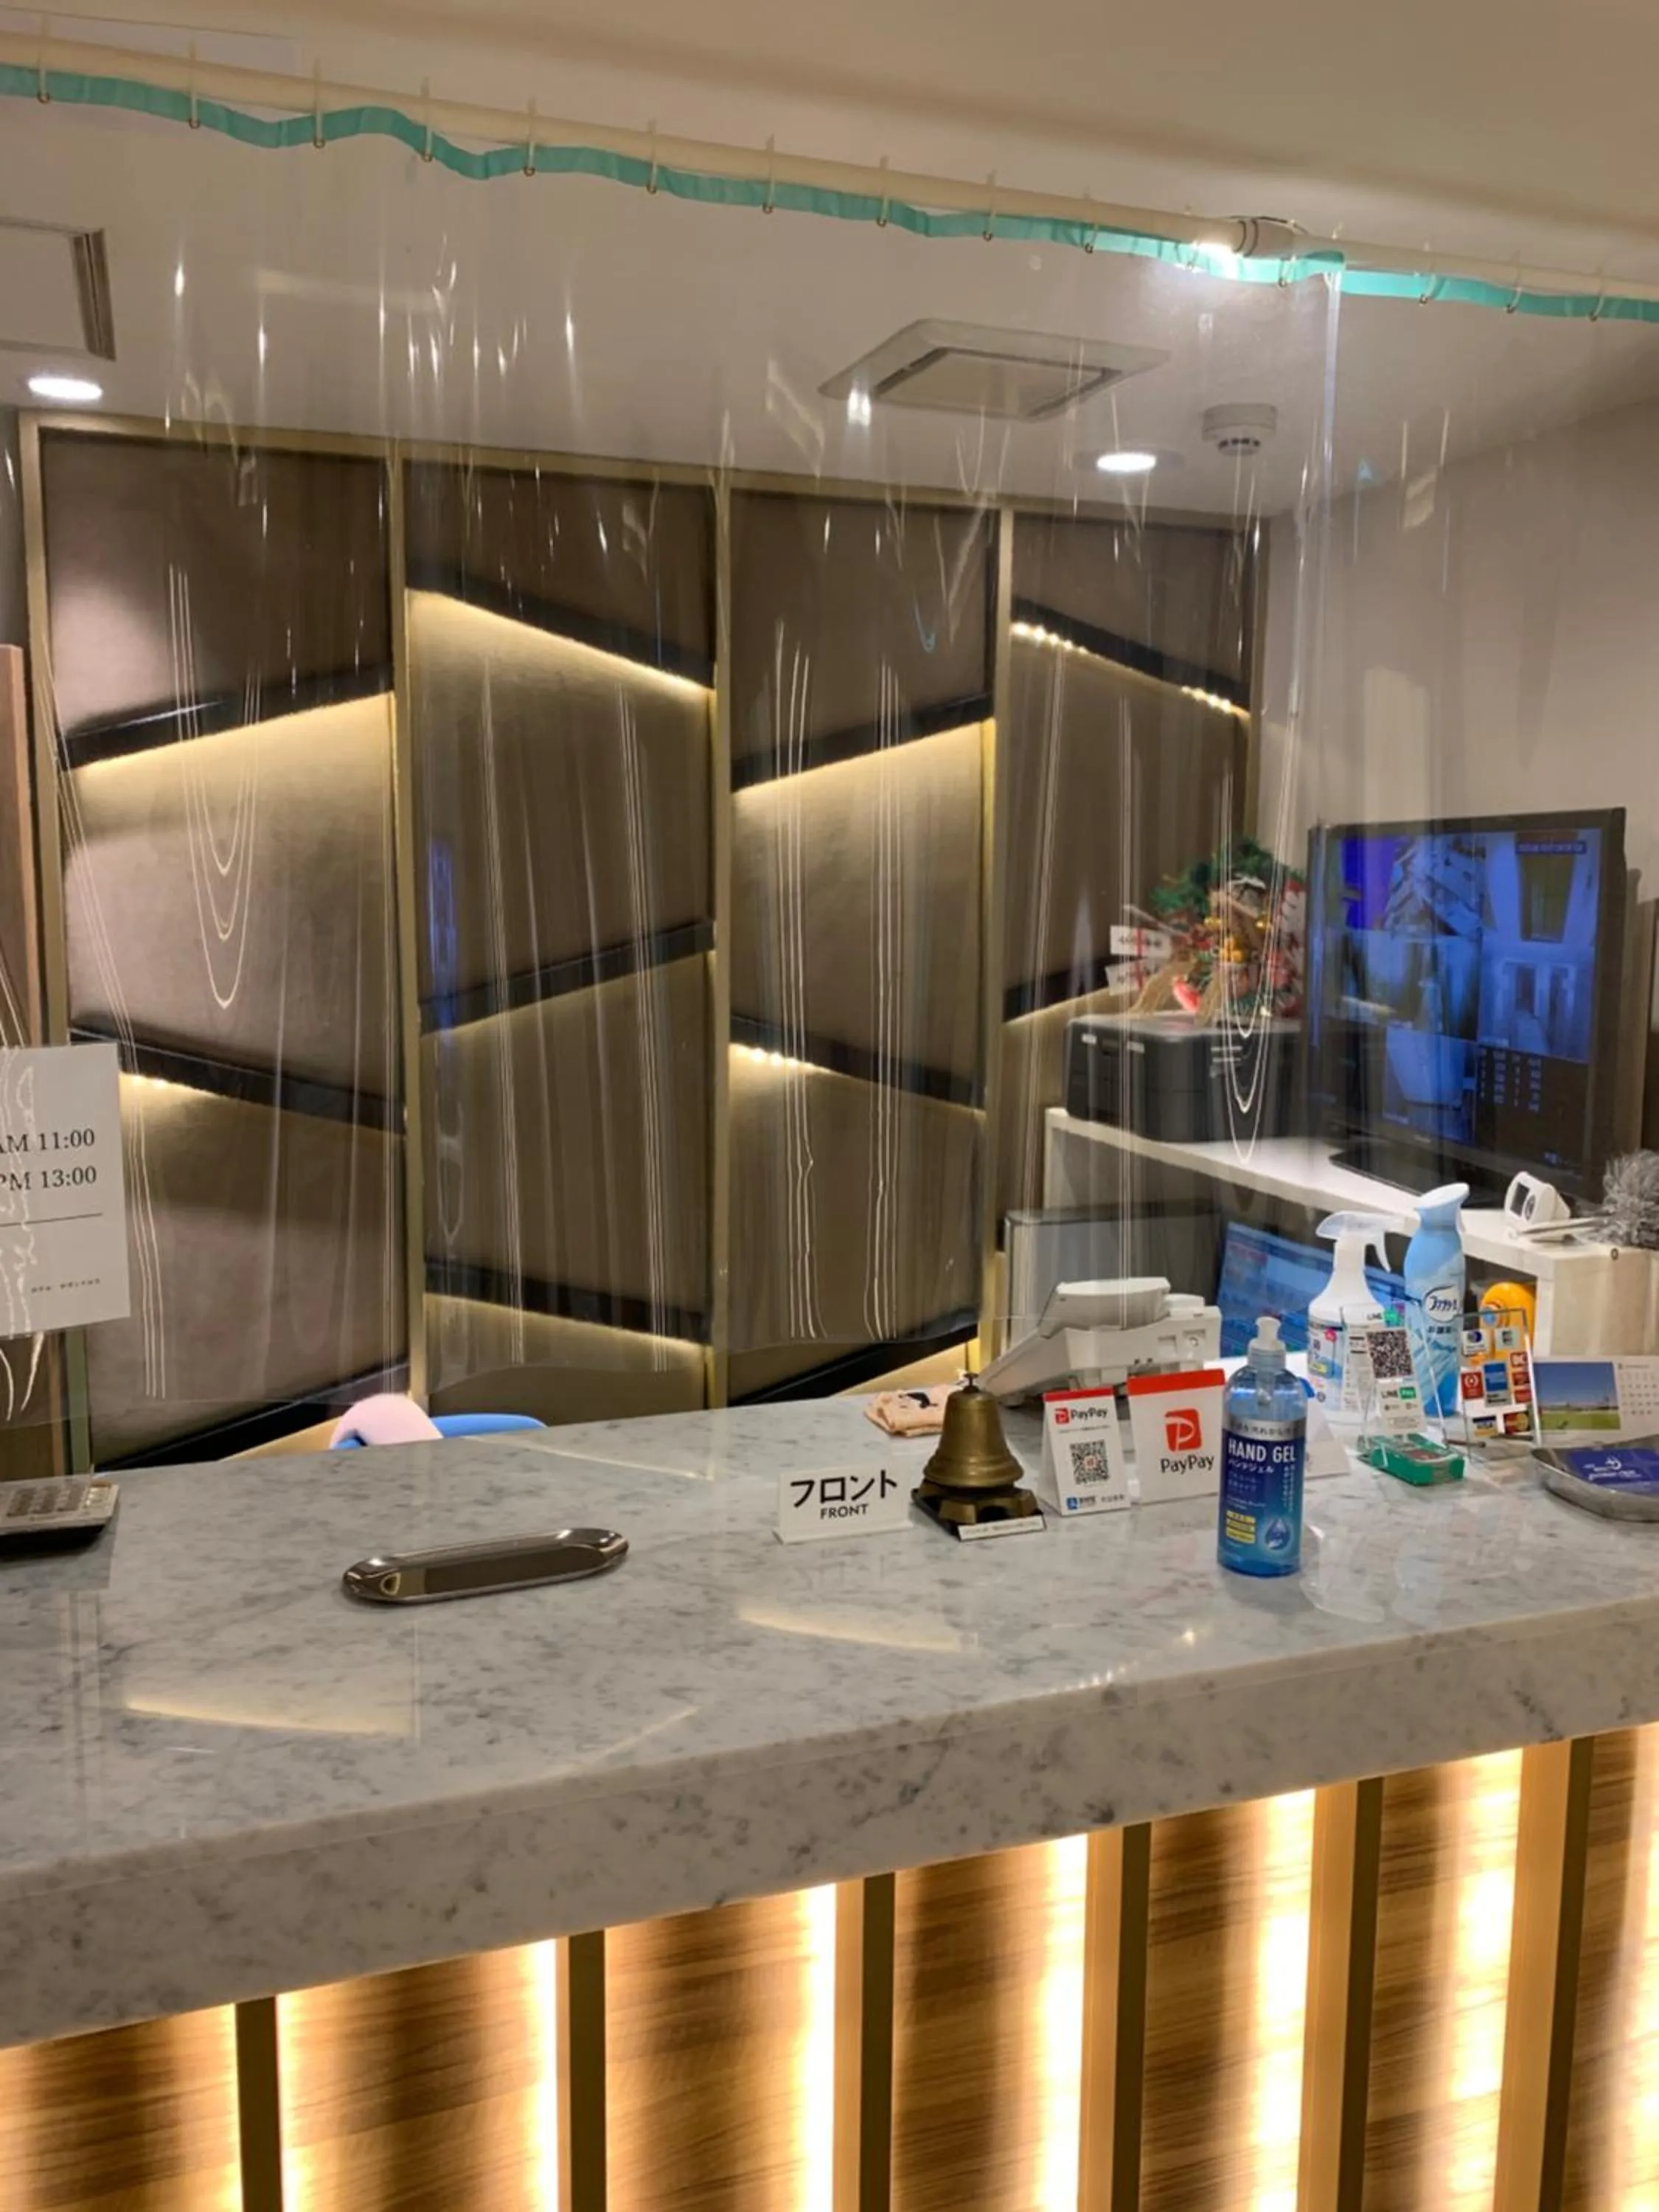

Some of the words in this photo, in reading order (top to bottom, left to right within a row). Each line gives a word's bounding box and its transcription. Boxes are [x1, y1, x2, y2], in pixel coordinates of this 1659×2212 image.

[39, 1128, 95, 1151] 11:00
[42, 1166, 97, 1189] 13:00
[1071, 1407, 1108, 1421] PayPay
[1228, 1439, 1267, 1462] HAND
[1272, 1445, 1296, 1464] GEL
[1160, 1454, 1215, 1475] PayPay
[790, 1470, 897, 1508] フロント
[821, 1503, 869, 1520] FRONT
